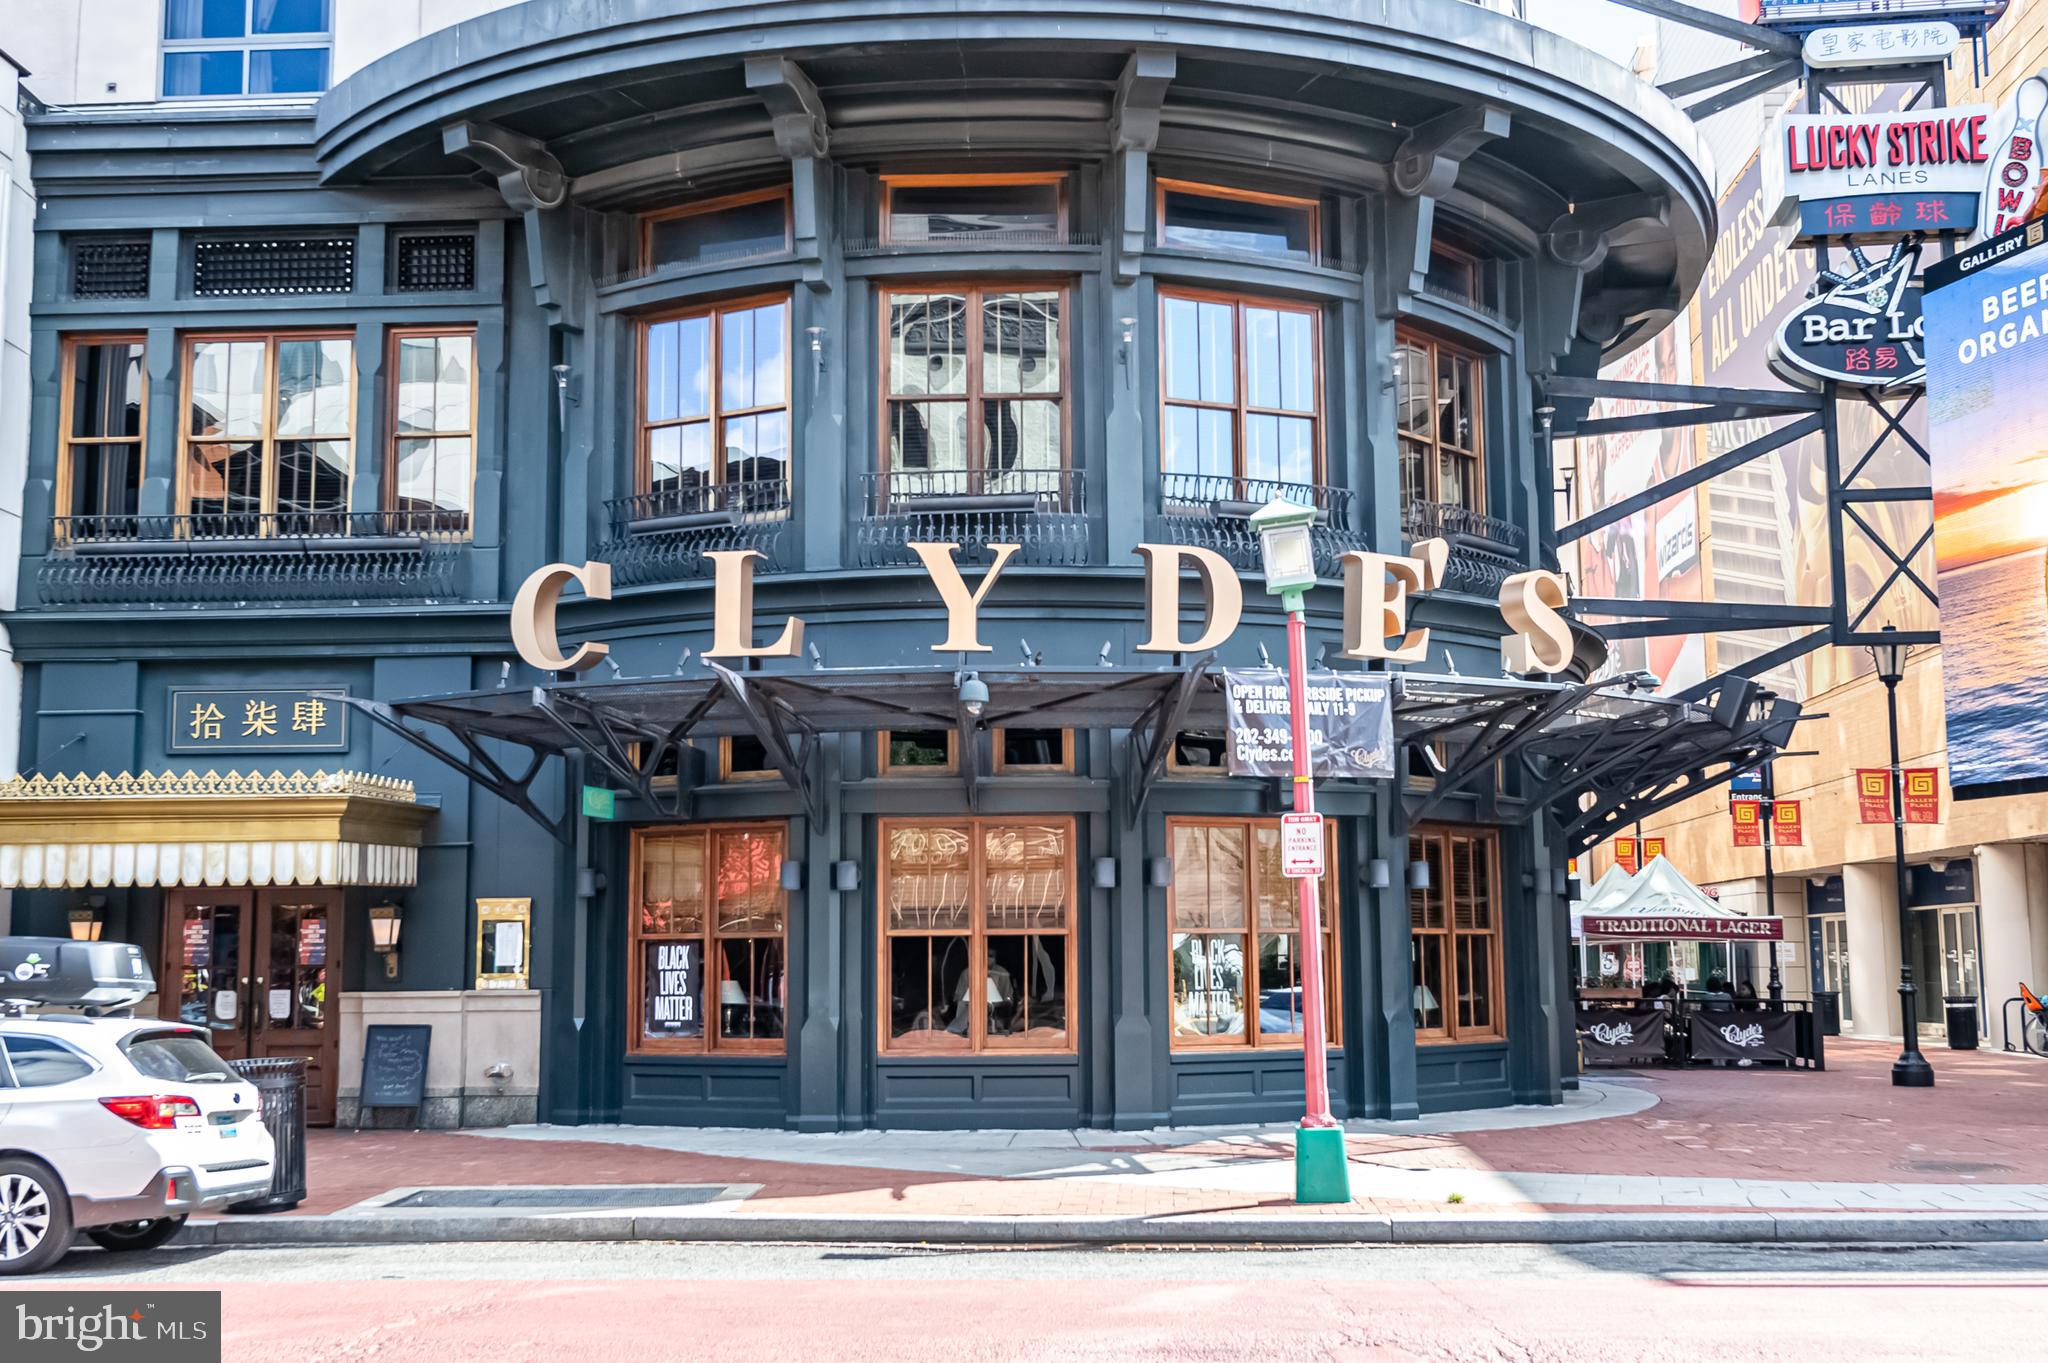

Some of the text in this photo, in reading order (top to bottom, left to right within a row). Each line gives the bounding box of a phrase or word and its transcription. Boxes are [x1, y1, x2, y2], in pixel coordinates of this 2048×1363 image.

[1819, 28, 1948, 57] 皇家電影院
[1788, 115, 1989, 172] LUCKY STRIKE
[1847, 170, 1929, 187] LANES
[1825, 199, 1950, 229] 保齡球
[1707, 188, 1766, 299] ENDLESS
[1959, 234, 2024, 271] GALLERY
[1711, 238, 1799, 373] ALL UNDER
[1801, 315, 1877, 343] Bar
[1845, 347, 1898, 371] 路易
[510, 536, 1575, 675] CLYDE'S
[1232, 684, 1385, 703] OPEN FOR RBSIDE PICKUP
[189, 698, 328, 740] 拾柒肆
[1233, 699, 1356, 716] & DELIVER AILY 11-9
[1731, 793, 1763, 801] Entranc
[1296, 827, 1306, 835] NO
[1595, 918, 1772, 935] TRADITIONAL LAGER
[657, 945, 690, 970] BLACK
[659, 971, 687, 995] LIVES
[654, 996, 693, 1021] MATTER
